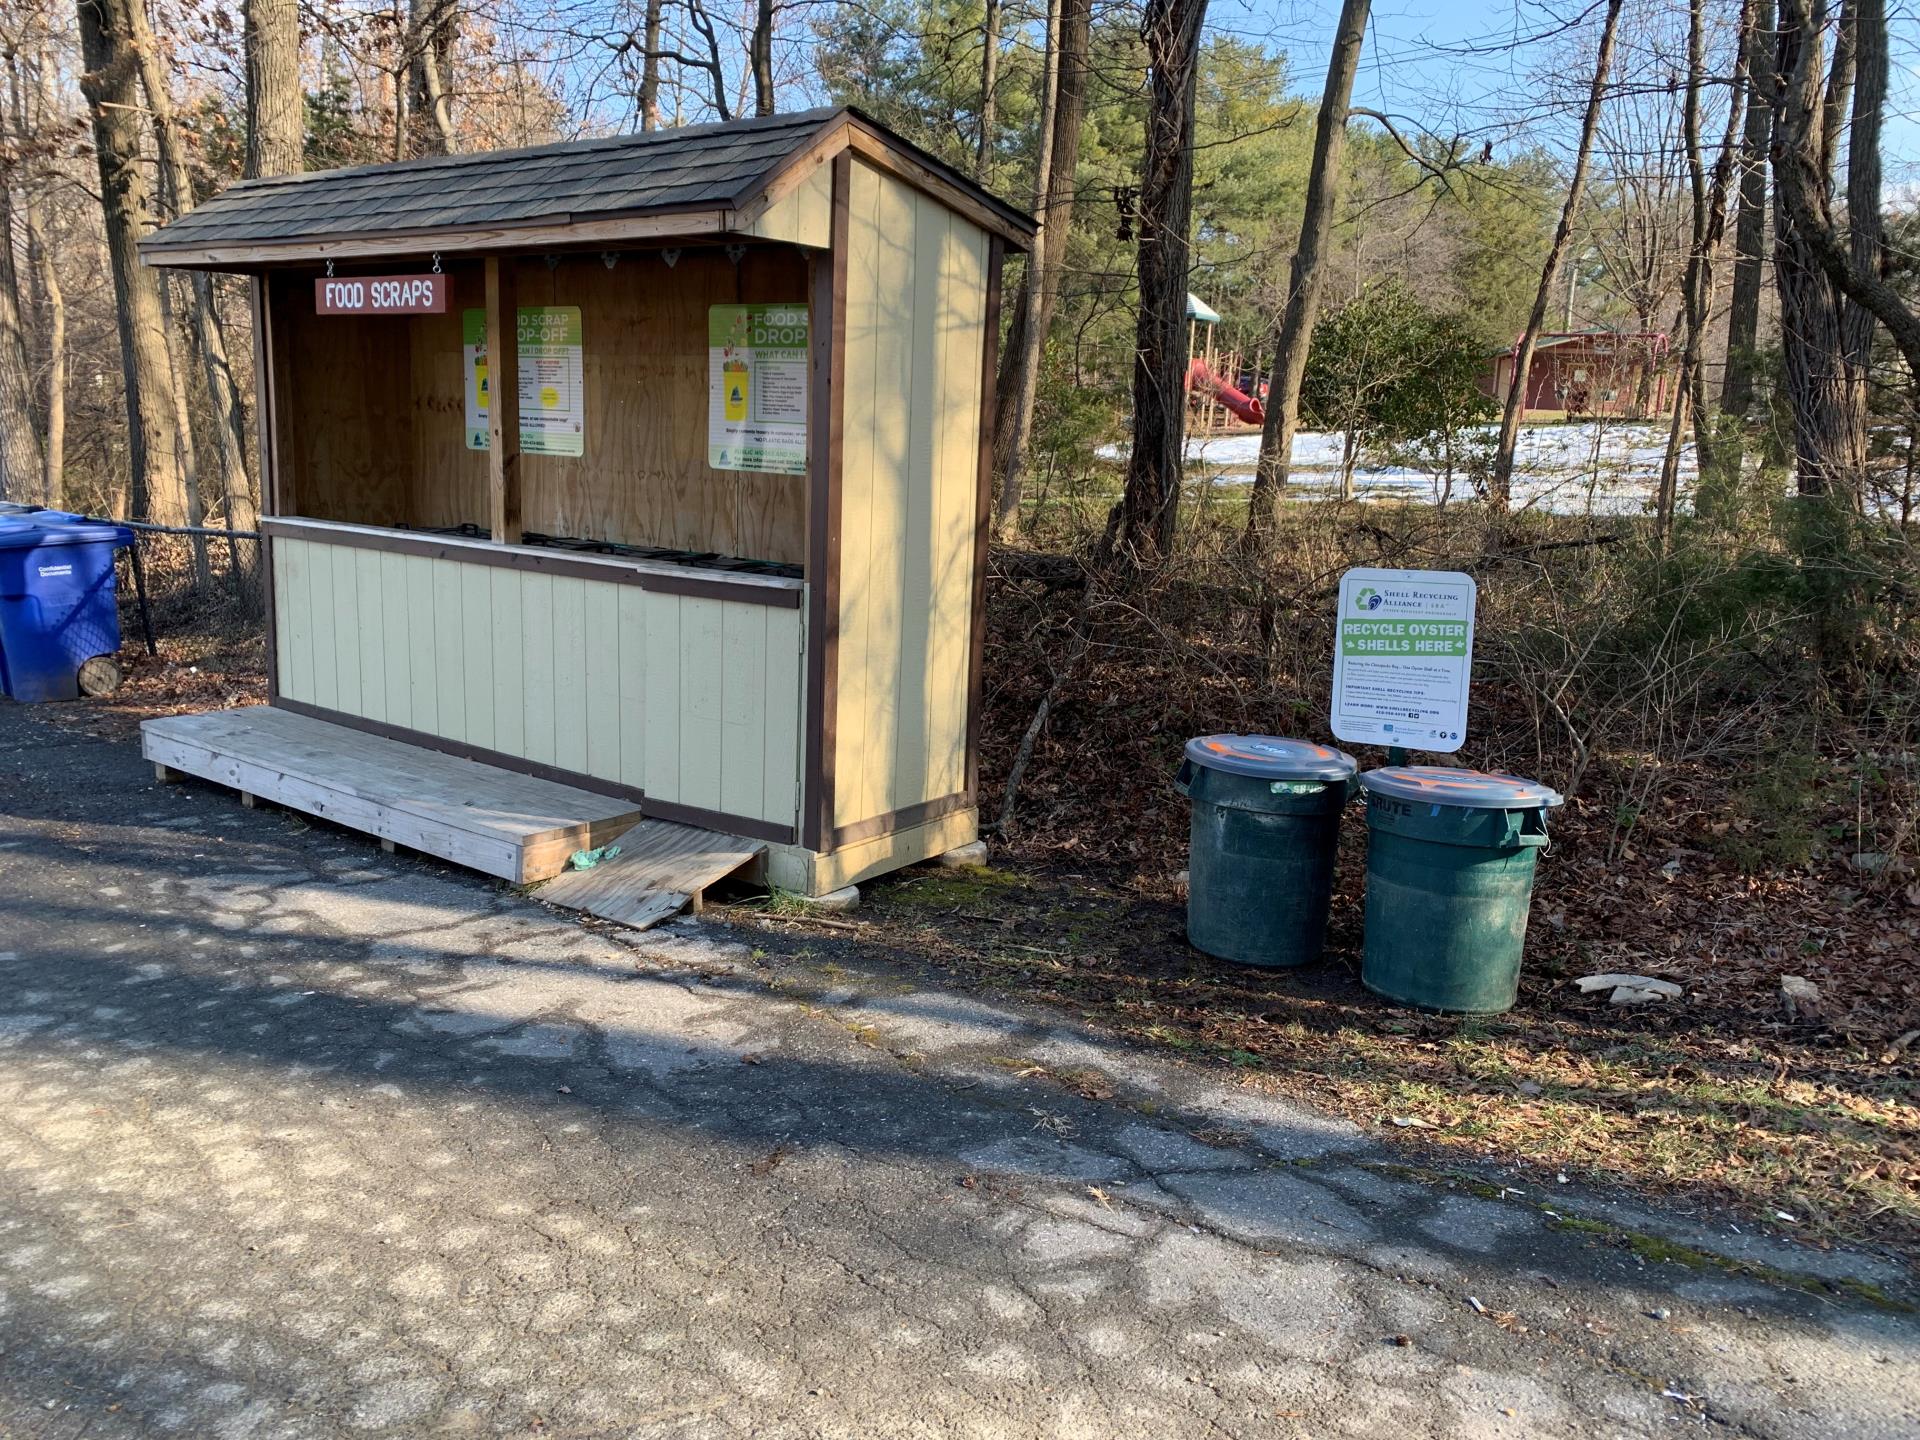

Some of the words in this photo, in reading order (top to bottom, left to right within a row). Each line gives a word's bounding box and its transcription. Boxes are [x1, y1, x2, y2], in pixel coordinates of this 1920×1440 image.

[326, 282, 364, 308] FOOD
[371, 280, 433, 308] SCRAPS
[531, 314, 569, 326] SCRAP
[754, 313, 797, 326] FOOD
[517, 328, 568, 342] OP-OFF
[755, 350, 779, 360] WHAT
[780, 350, 799, 360] CAN
[1384, 589, 1410, 599] SHELL
[1412, 591, 1459, 602] RECYCLING
[1383, 599, 1423, 608] ALLIANCE
[1344, 623, 1406, 636] RECYCLE
[1409, 624, 1465, 637] OYSTER
[1357, 639, 1410, 652] SHELLS
[1415, 641, 1454, 652] HERE
